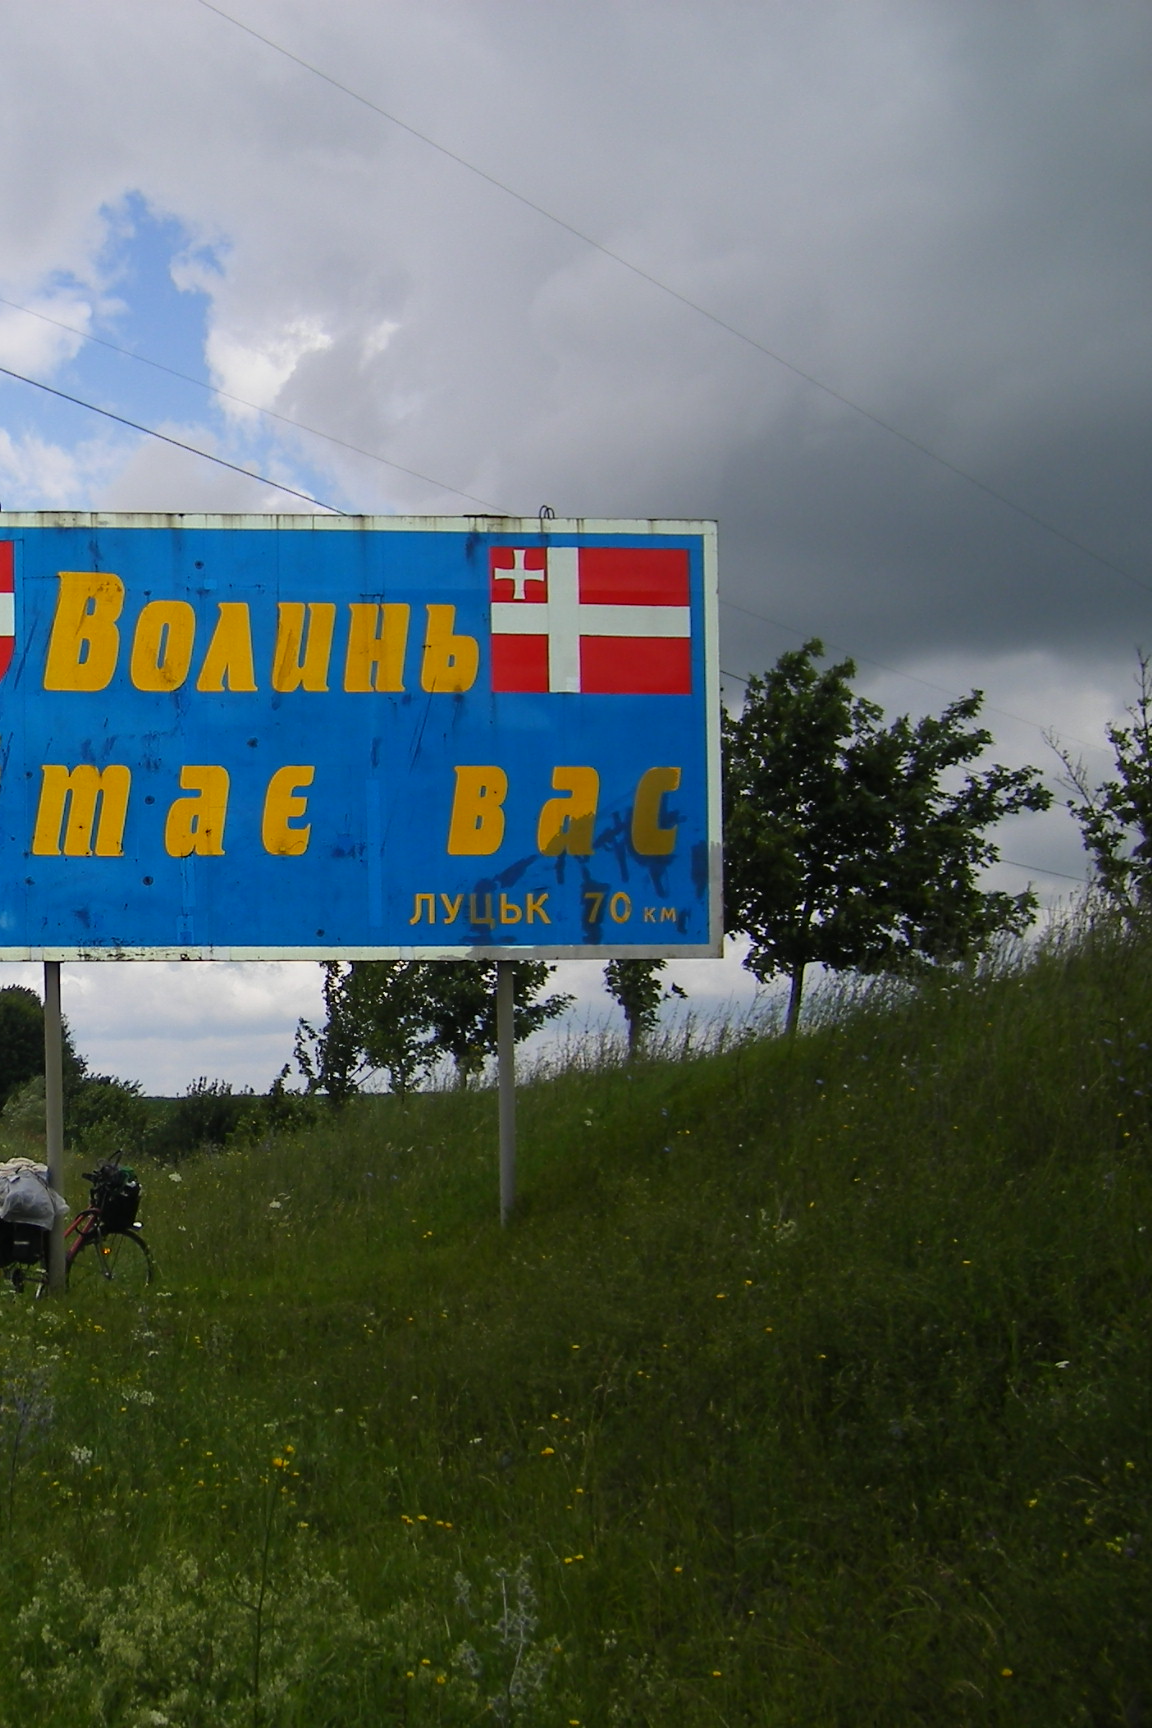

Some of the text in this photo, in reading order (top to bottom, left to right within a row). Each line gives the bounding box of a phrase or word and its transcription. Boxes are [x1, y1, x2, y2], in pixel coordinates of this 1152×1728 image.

[43, 571, 480, 693] Волинь
[448, 765, 683, 856] вас
[409, 892, 551, 929] ЛУЦЬК
[584, 891, 632, 923] 70
